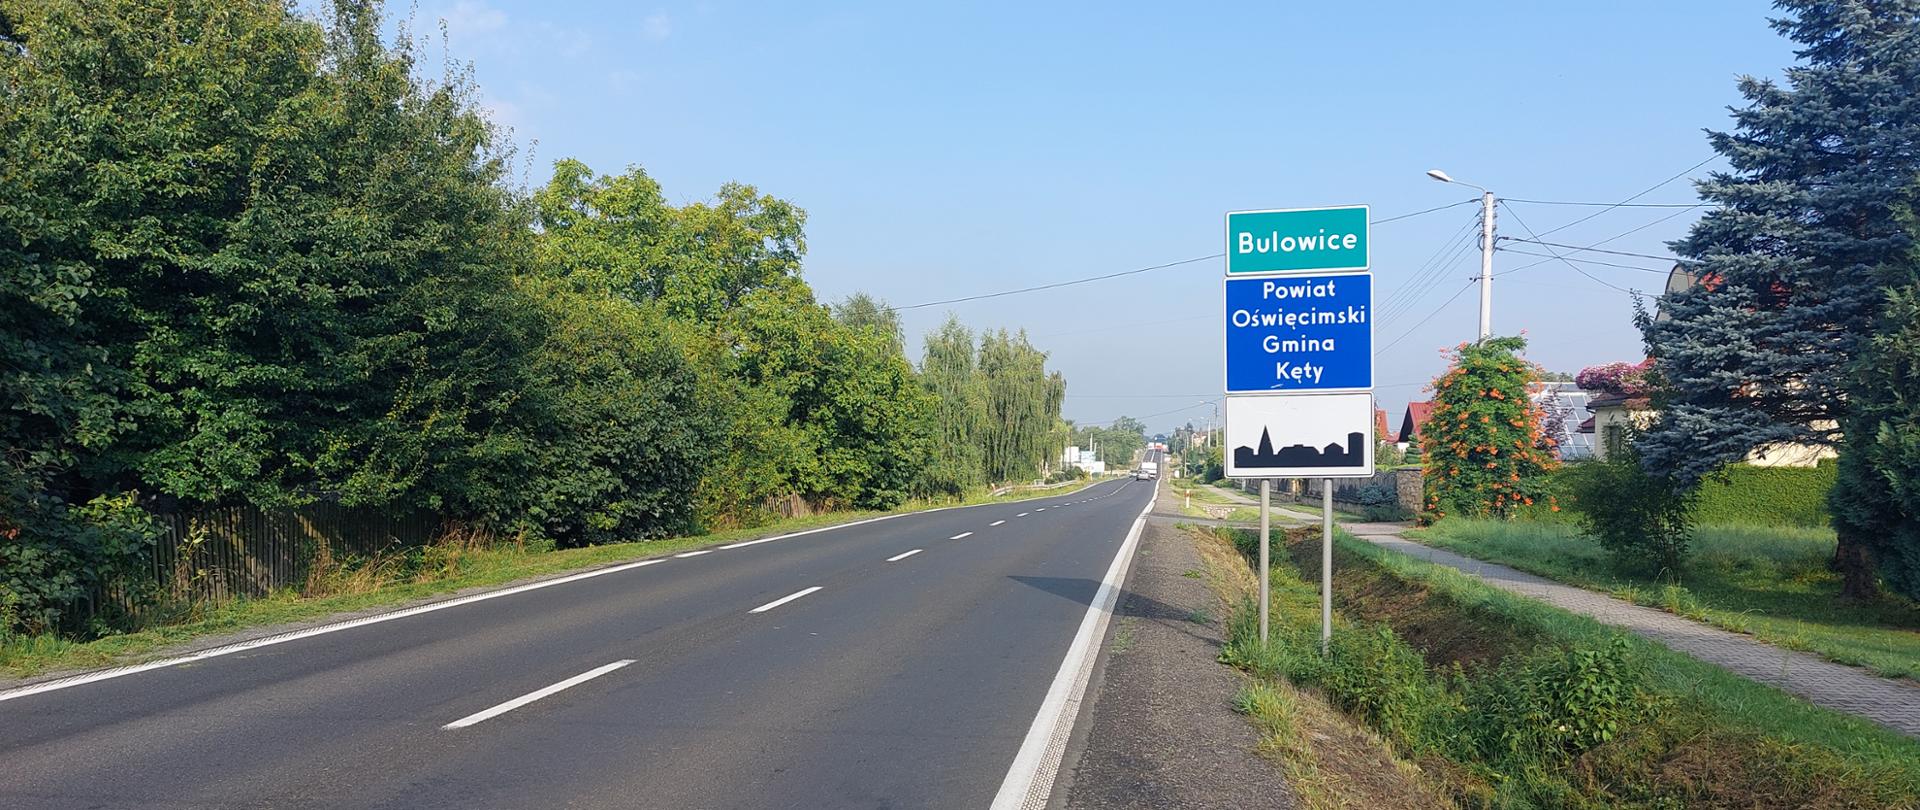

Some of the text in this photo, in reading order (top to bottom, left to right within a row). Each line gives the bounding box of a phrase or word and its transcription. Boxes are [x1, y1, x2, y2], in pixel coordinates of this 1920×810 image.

[1238, 228, 1358, 254] Bulowice
[1263, 279, 1336, 299] Powiat
[1232, 305, 1366, 330] Oświęcimski
[1262, 335, 1335, 354] Gmina
[1276, 361, 1324, 384] Kęty
